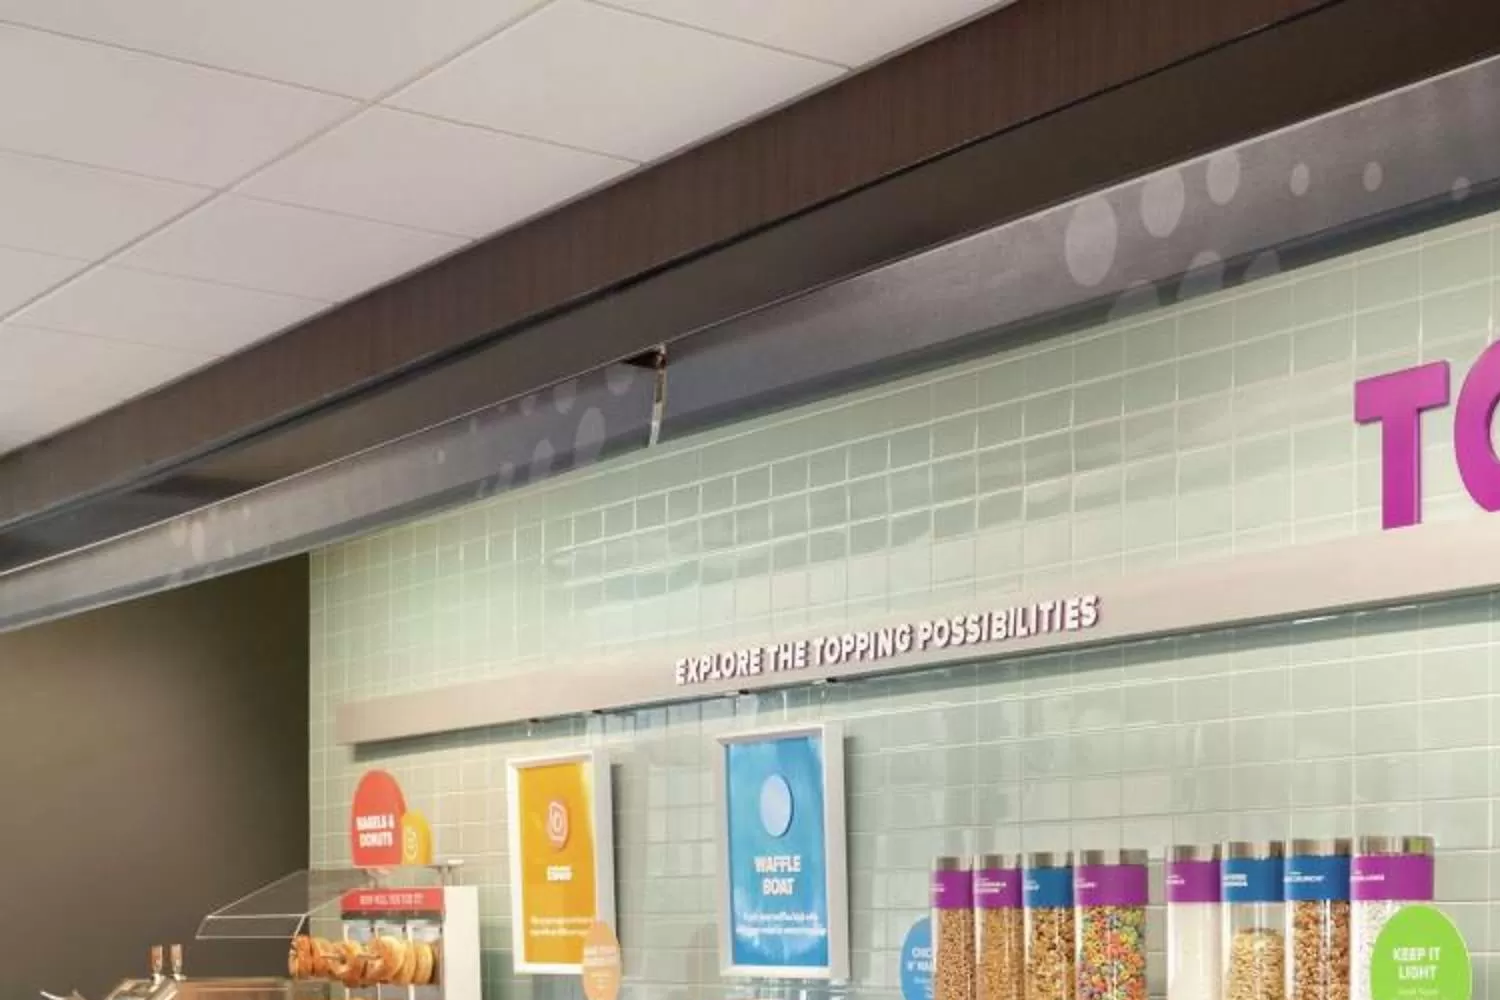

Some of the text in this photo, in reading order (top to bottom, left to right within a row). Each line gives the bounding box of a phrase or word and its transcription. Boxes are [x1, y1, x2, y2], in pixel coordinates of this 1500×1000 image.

[675, 594, 1101, 685] EXPLORE THE TOPPING POSSIBILITIES
[753, 855, 801, 872] WAFFLE
[763, 877, 795, 896] BOAT
[1393, 945, 1441, 961] KEEP IT
[1398, 964, 1438, 981] LIGHT
